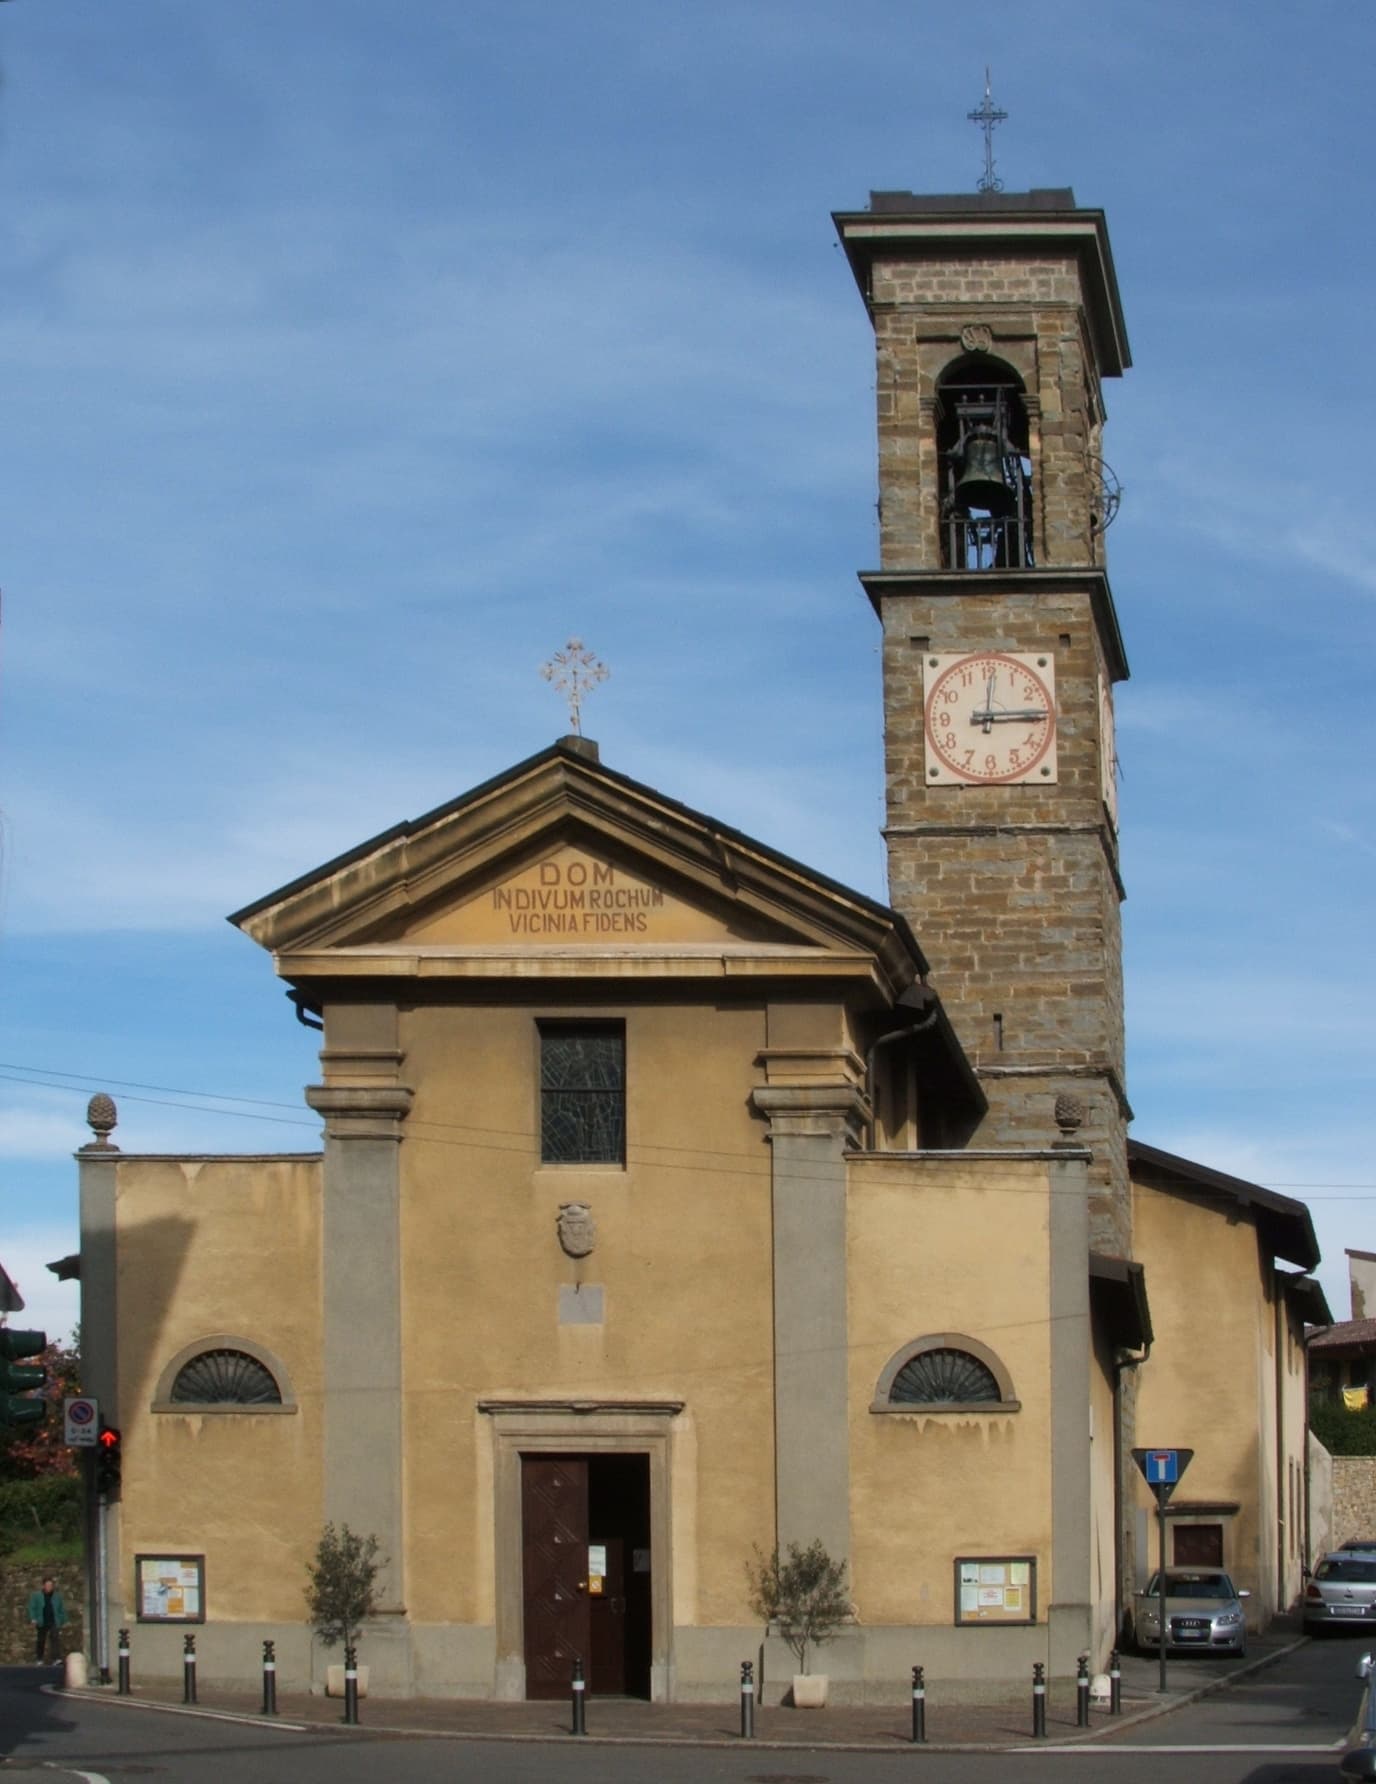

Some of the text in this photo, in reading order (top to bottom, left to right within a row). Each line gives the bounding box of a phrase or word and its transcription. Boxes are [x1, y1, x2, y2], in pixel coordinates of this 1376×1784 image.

[962, 671, 972, 687] 11
[1009, 672, 1014, 687] 1
[942, 690, 958, 704] 10
[1024, 686, 1033, 701] 2
[940, 712, 950, 727] 9
[946, 732, 956, 749] 8
[965, 750, 975, 765] 7
[985, 754, 996, 770] 6
[1009, 749, 1019, 764] 5
[509, 912, 648, 933] VICINIA FIDENS
